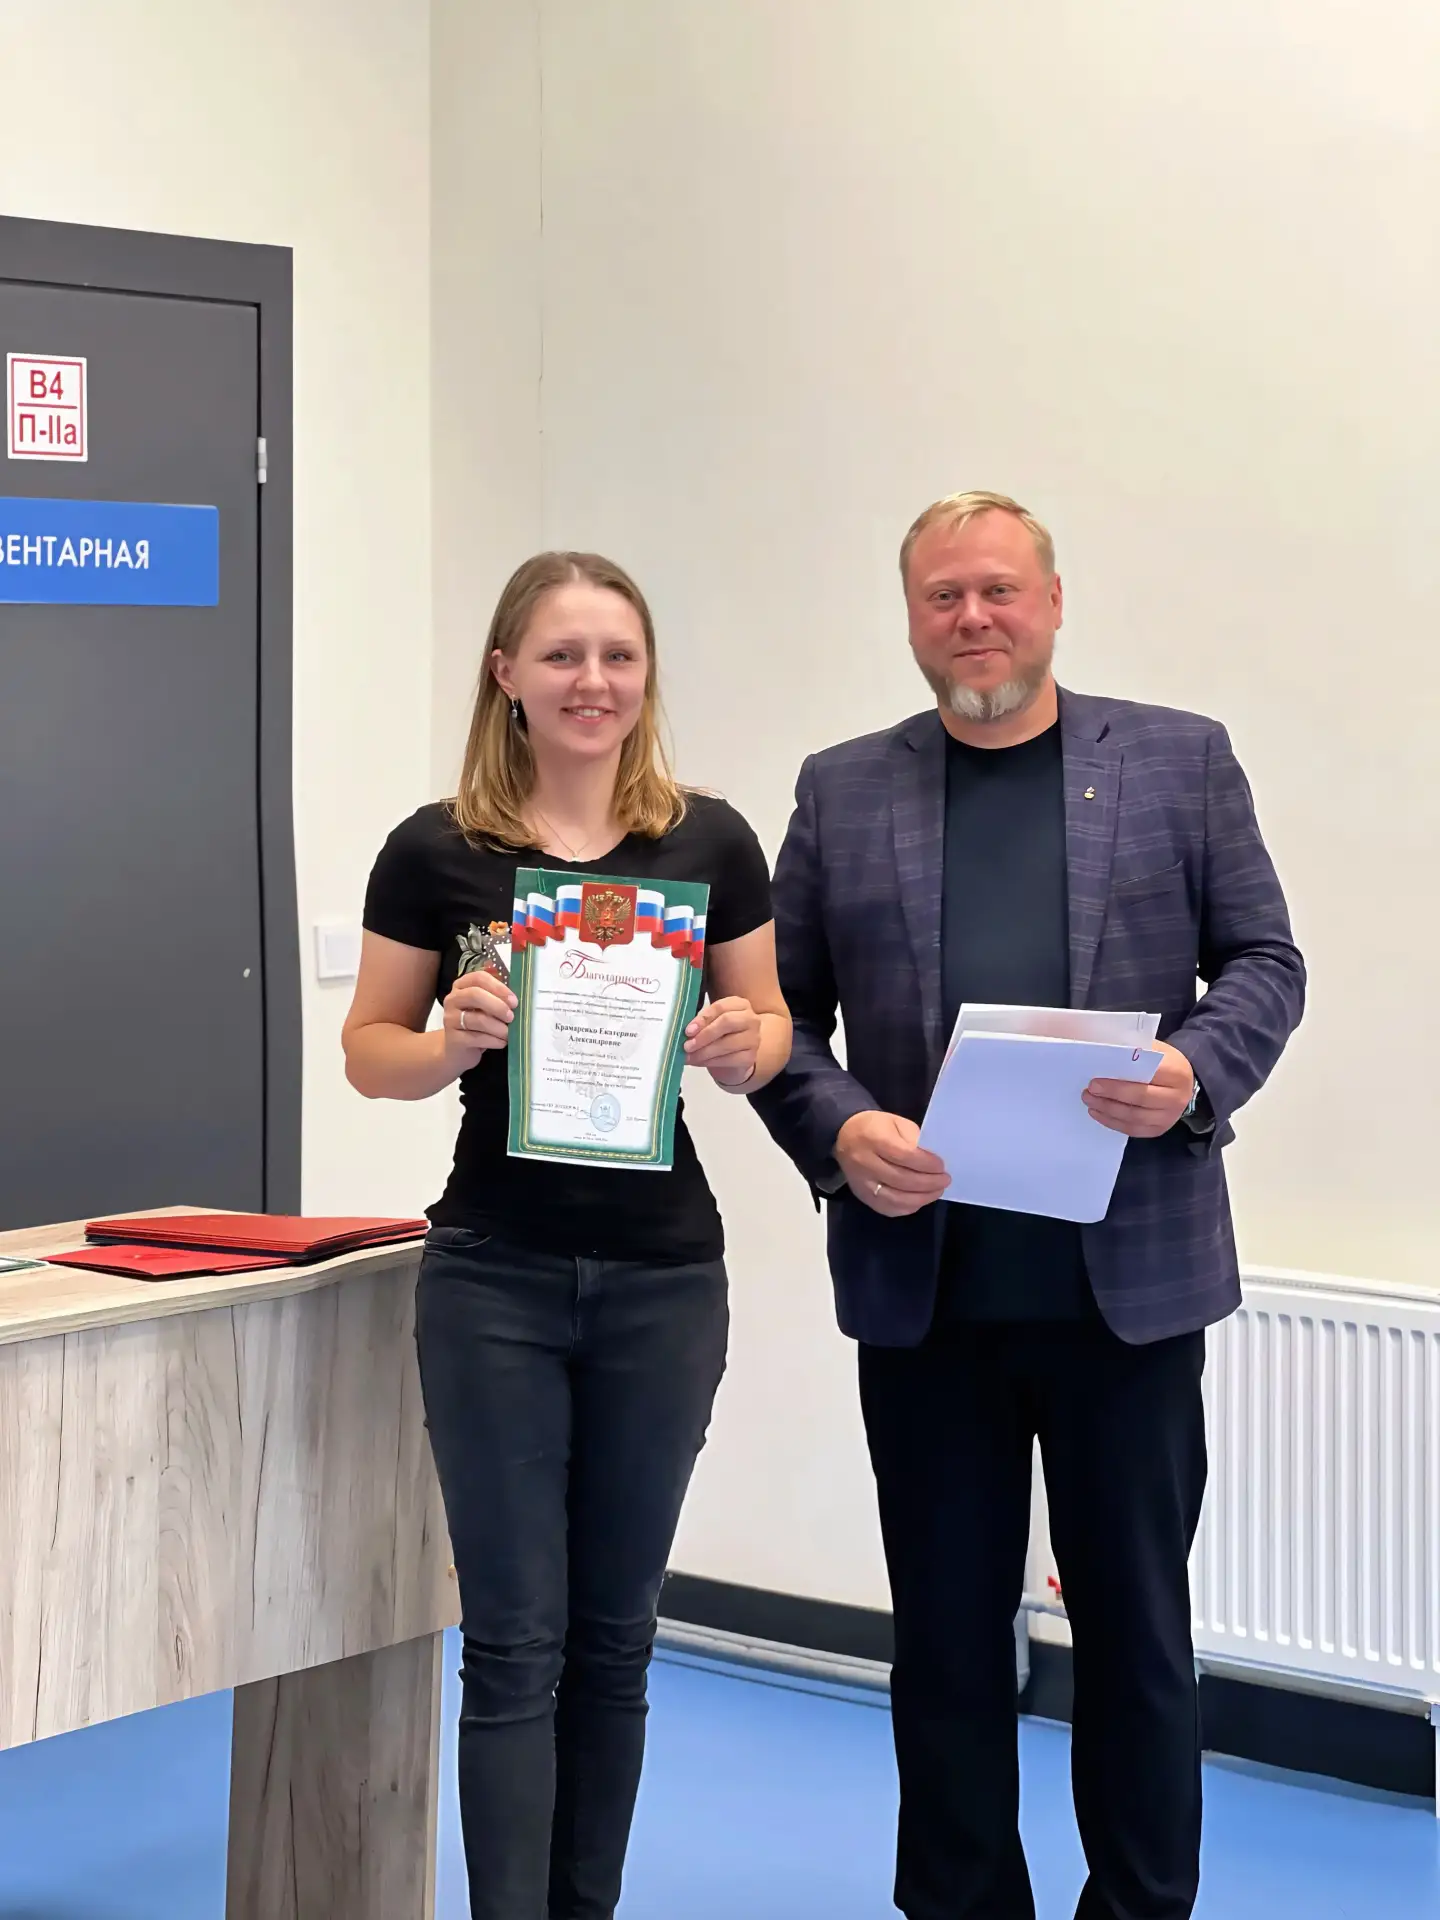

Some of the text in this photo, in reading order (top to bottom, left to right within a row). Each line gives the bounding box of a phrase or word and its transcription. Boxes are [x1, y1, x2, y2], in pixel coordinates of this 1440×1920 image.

[30, 369, 64, 400] В4
[559, 949, 661, 994] Благодарность
[555, 1022, 639, 1039] Крамаренко Екатерине
[568, 1035, 622, 1047] Александровне
